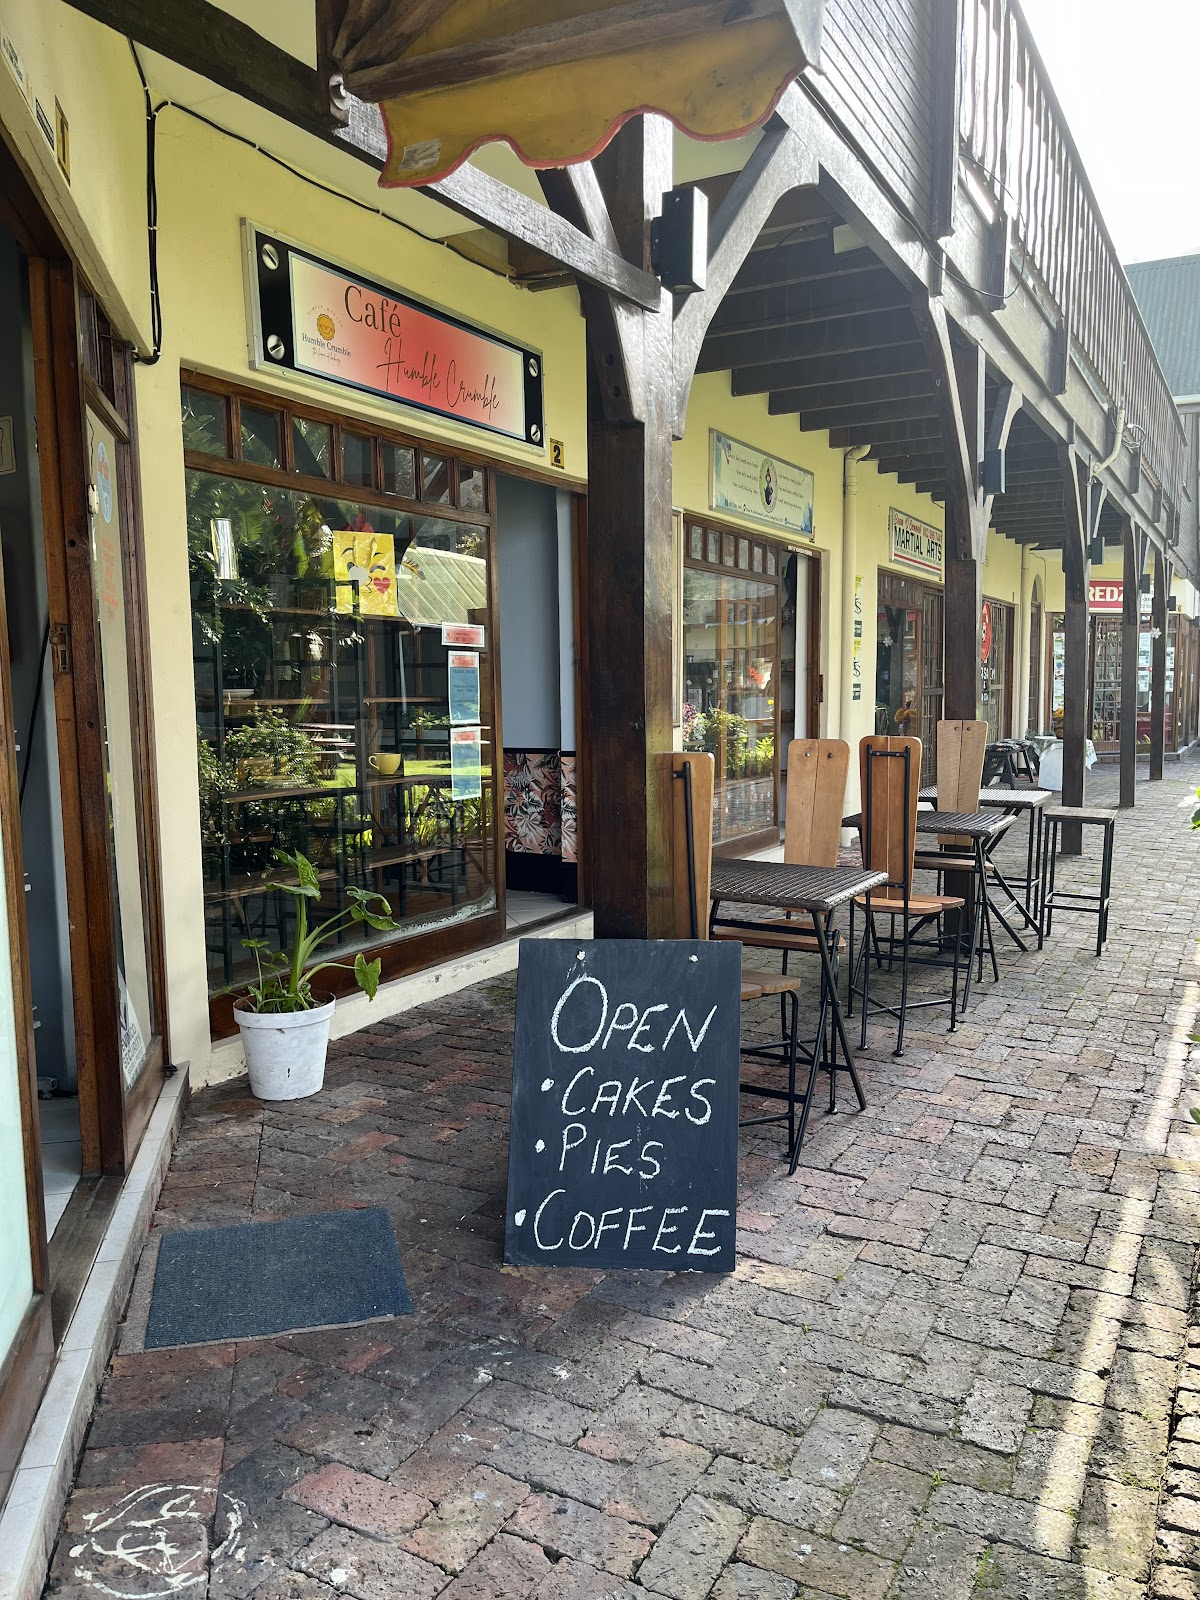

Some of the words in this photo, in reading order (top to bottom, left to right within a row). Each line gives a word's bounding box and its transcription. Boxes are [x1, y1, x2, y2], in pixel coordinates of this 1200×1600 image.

[344, 285, 401, 338] Café
[302, 333, 326, 349] Humble
[326, 341, 351, 357] Crumble
[377, 337, 441, 400] Humble
[446, 359, 500, 420] Crumble
[553, 444, 561, 464] 2
[894, 525, 923, 556] MARTIAL
[926, 538, 942, 562] ARTS
[550, 975, 717, 1053] OPEN
[561, 1066, 717, 1125] CAKES
[559, 1122, 664, 1180] PIES
[533, 1188, 731, 1256] COFFEE
